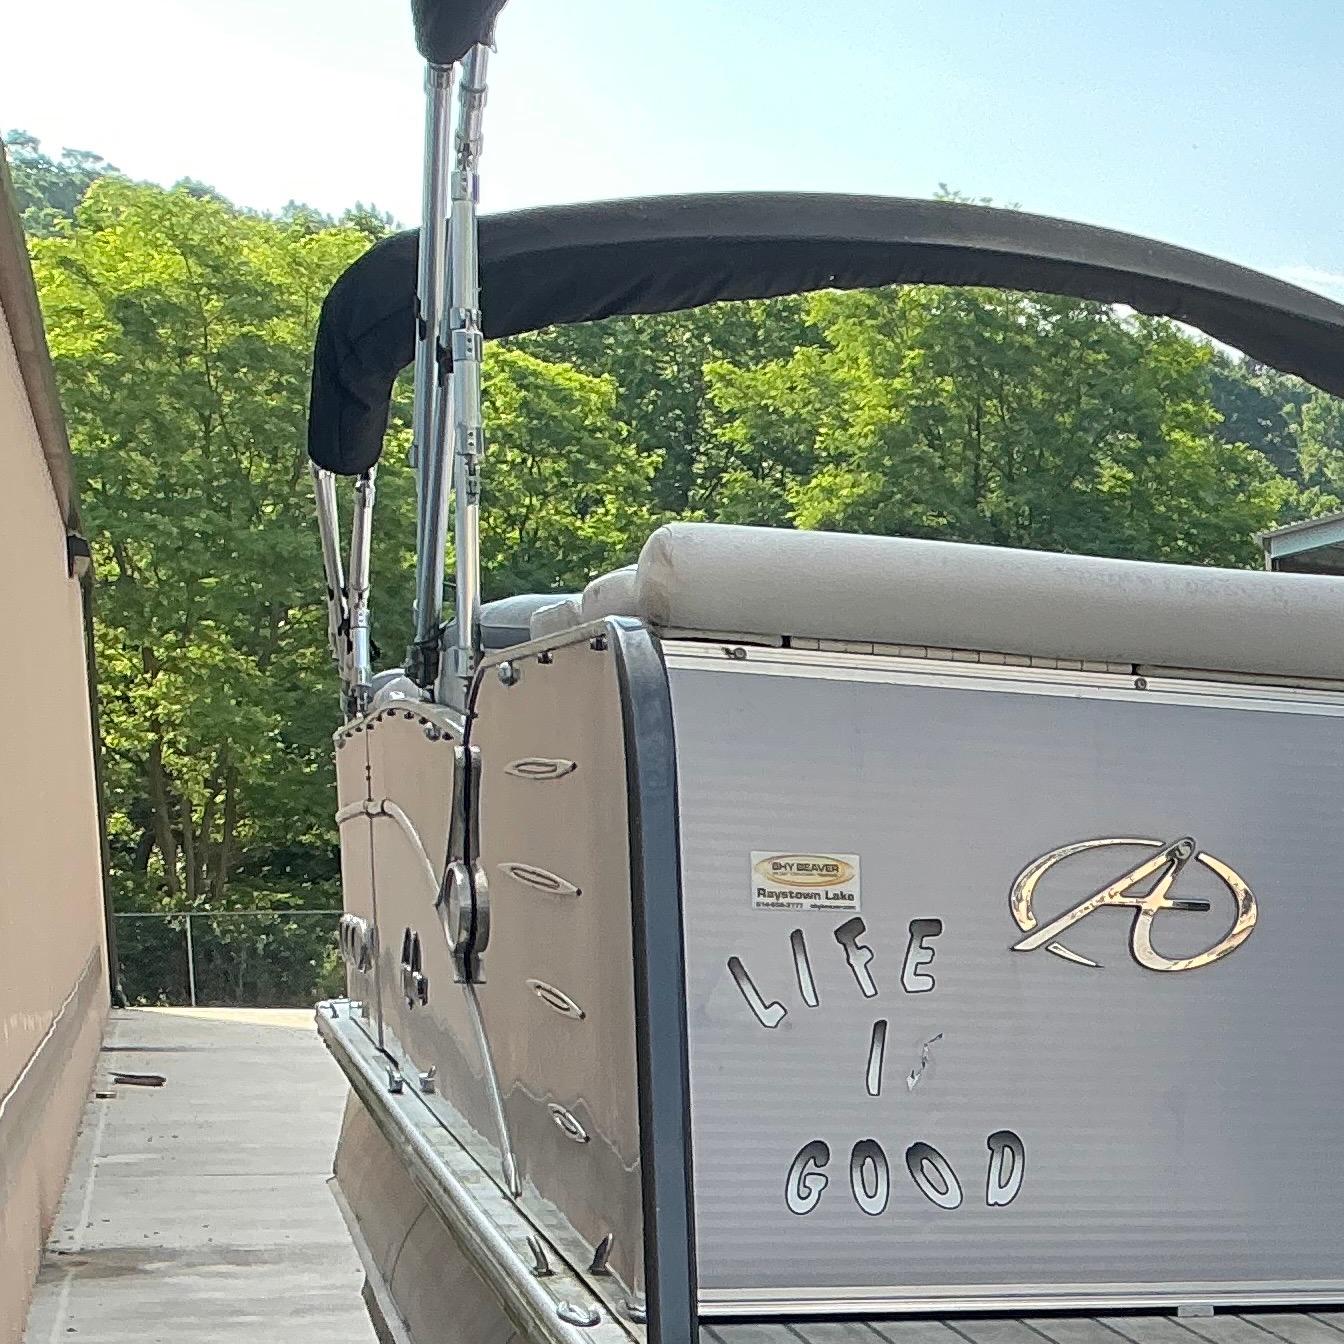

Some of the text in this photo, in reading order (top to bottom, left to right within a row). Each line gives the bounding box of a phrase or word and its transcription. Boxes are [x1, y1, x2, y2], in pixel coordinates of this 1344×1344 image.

[796, 863, 839, 873] BEAVER
[757, 888, 854, 901] Raystown Lake
[727, 916, 942, 1028] LIFE
[785, 1130, 1025, 1216] GOOD
